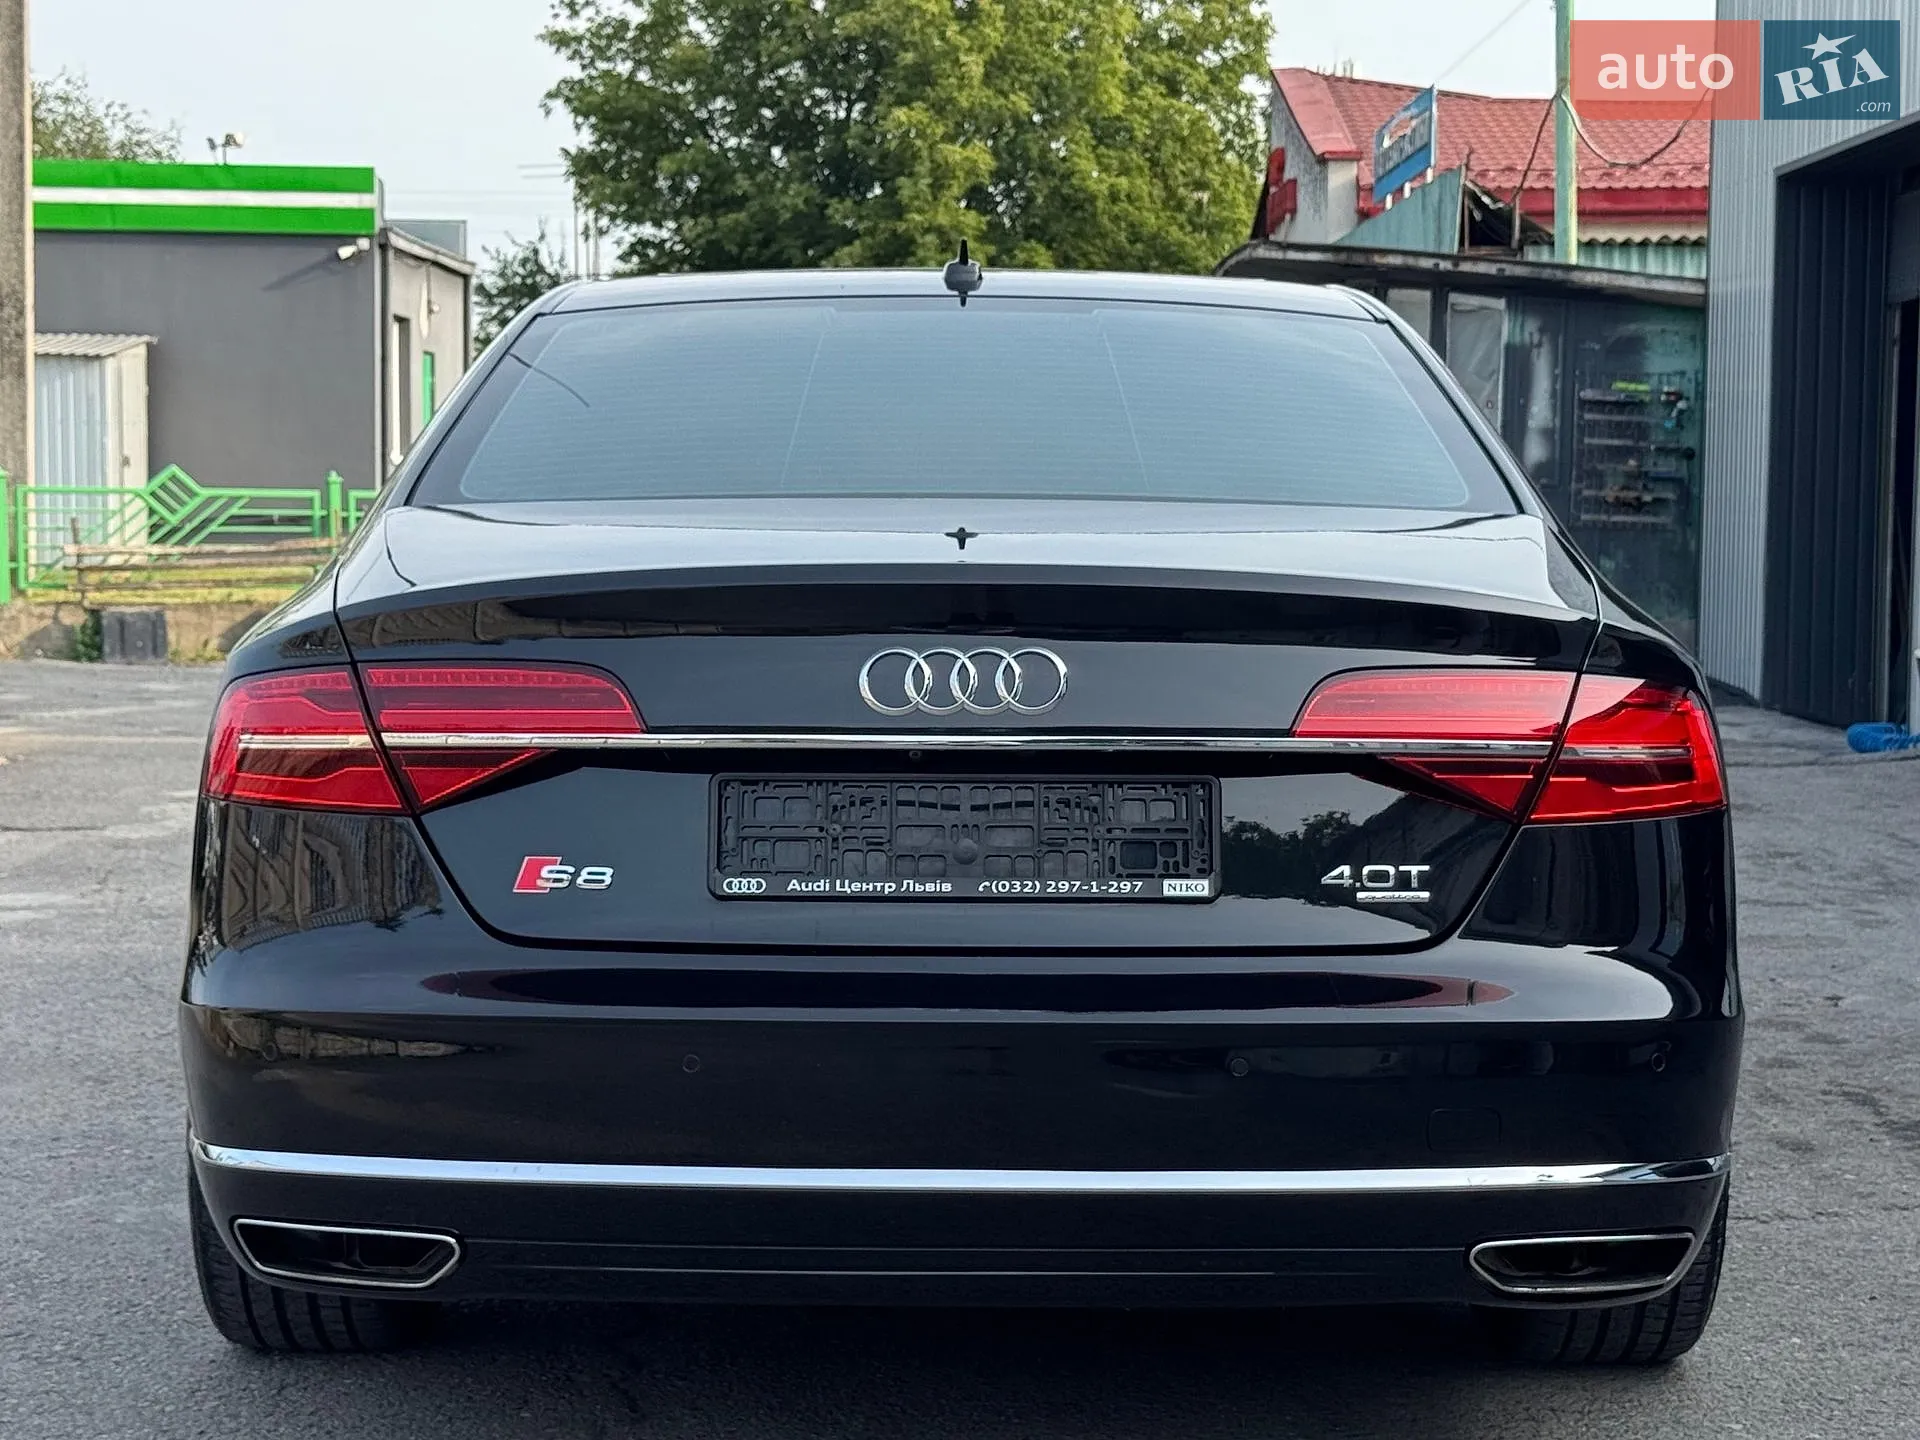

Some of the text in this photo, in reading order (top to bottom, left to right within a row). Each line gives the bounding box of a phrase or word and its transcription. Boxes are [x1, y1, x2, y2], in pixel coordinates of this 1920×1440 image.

[536, 864, 614, 889] S8
[1321, 865, 1431, 888] 4.0T
[787, 879, 1143, 894] Audi Центр Львів (032) 297-1-297
[1167, 883, 1205, 893] NIKO
